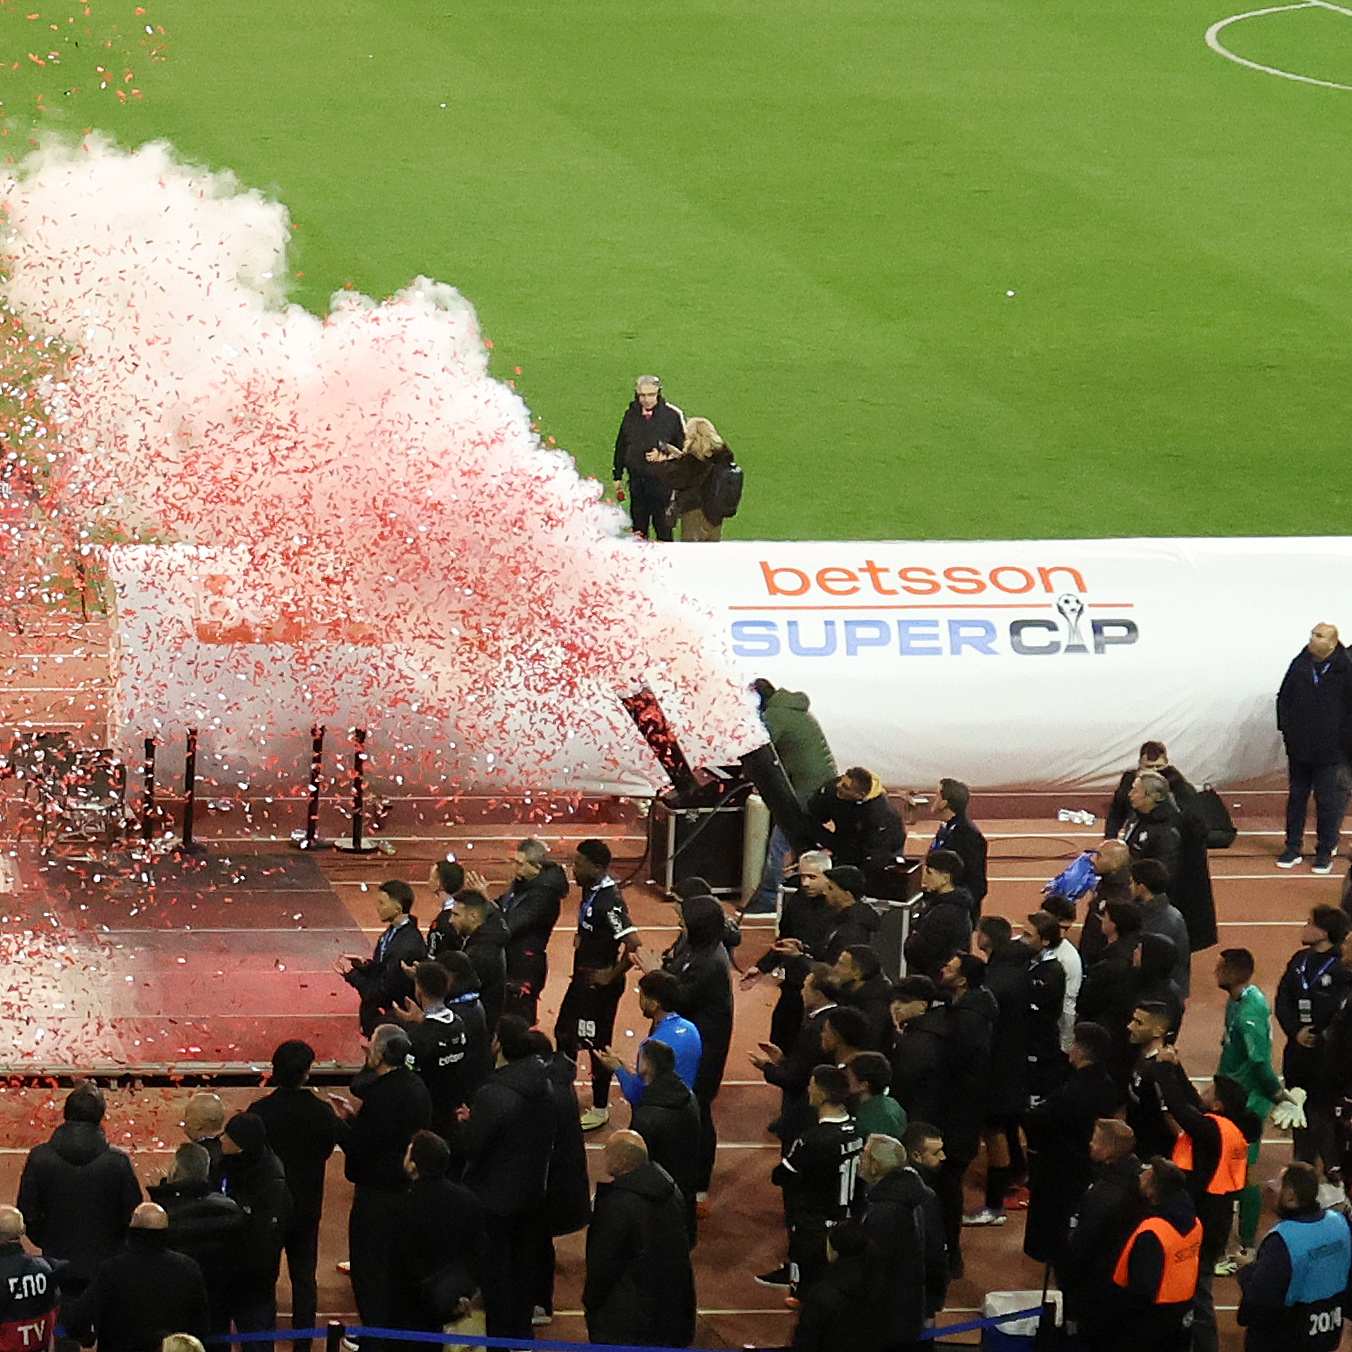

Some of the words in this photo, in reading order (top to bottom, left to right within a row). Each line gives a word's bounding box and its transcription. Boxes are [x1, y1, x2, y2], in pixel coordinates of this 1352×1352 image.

[758, 560, 1088, 597] betsson
[730, 619, 1001, 657] SUPER
[16, 1319, 46, 1346] TV
